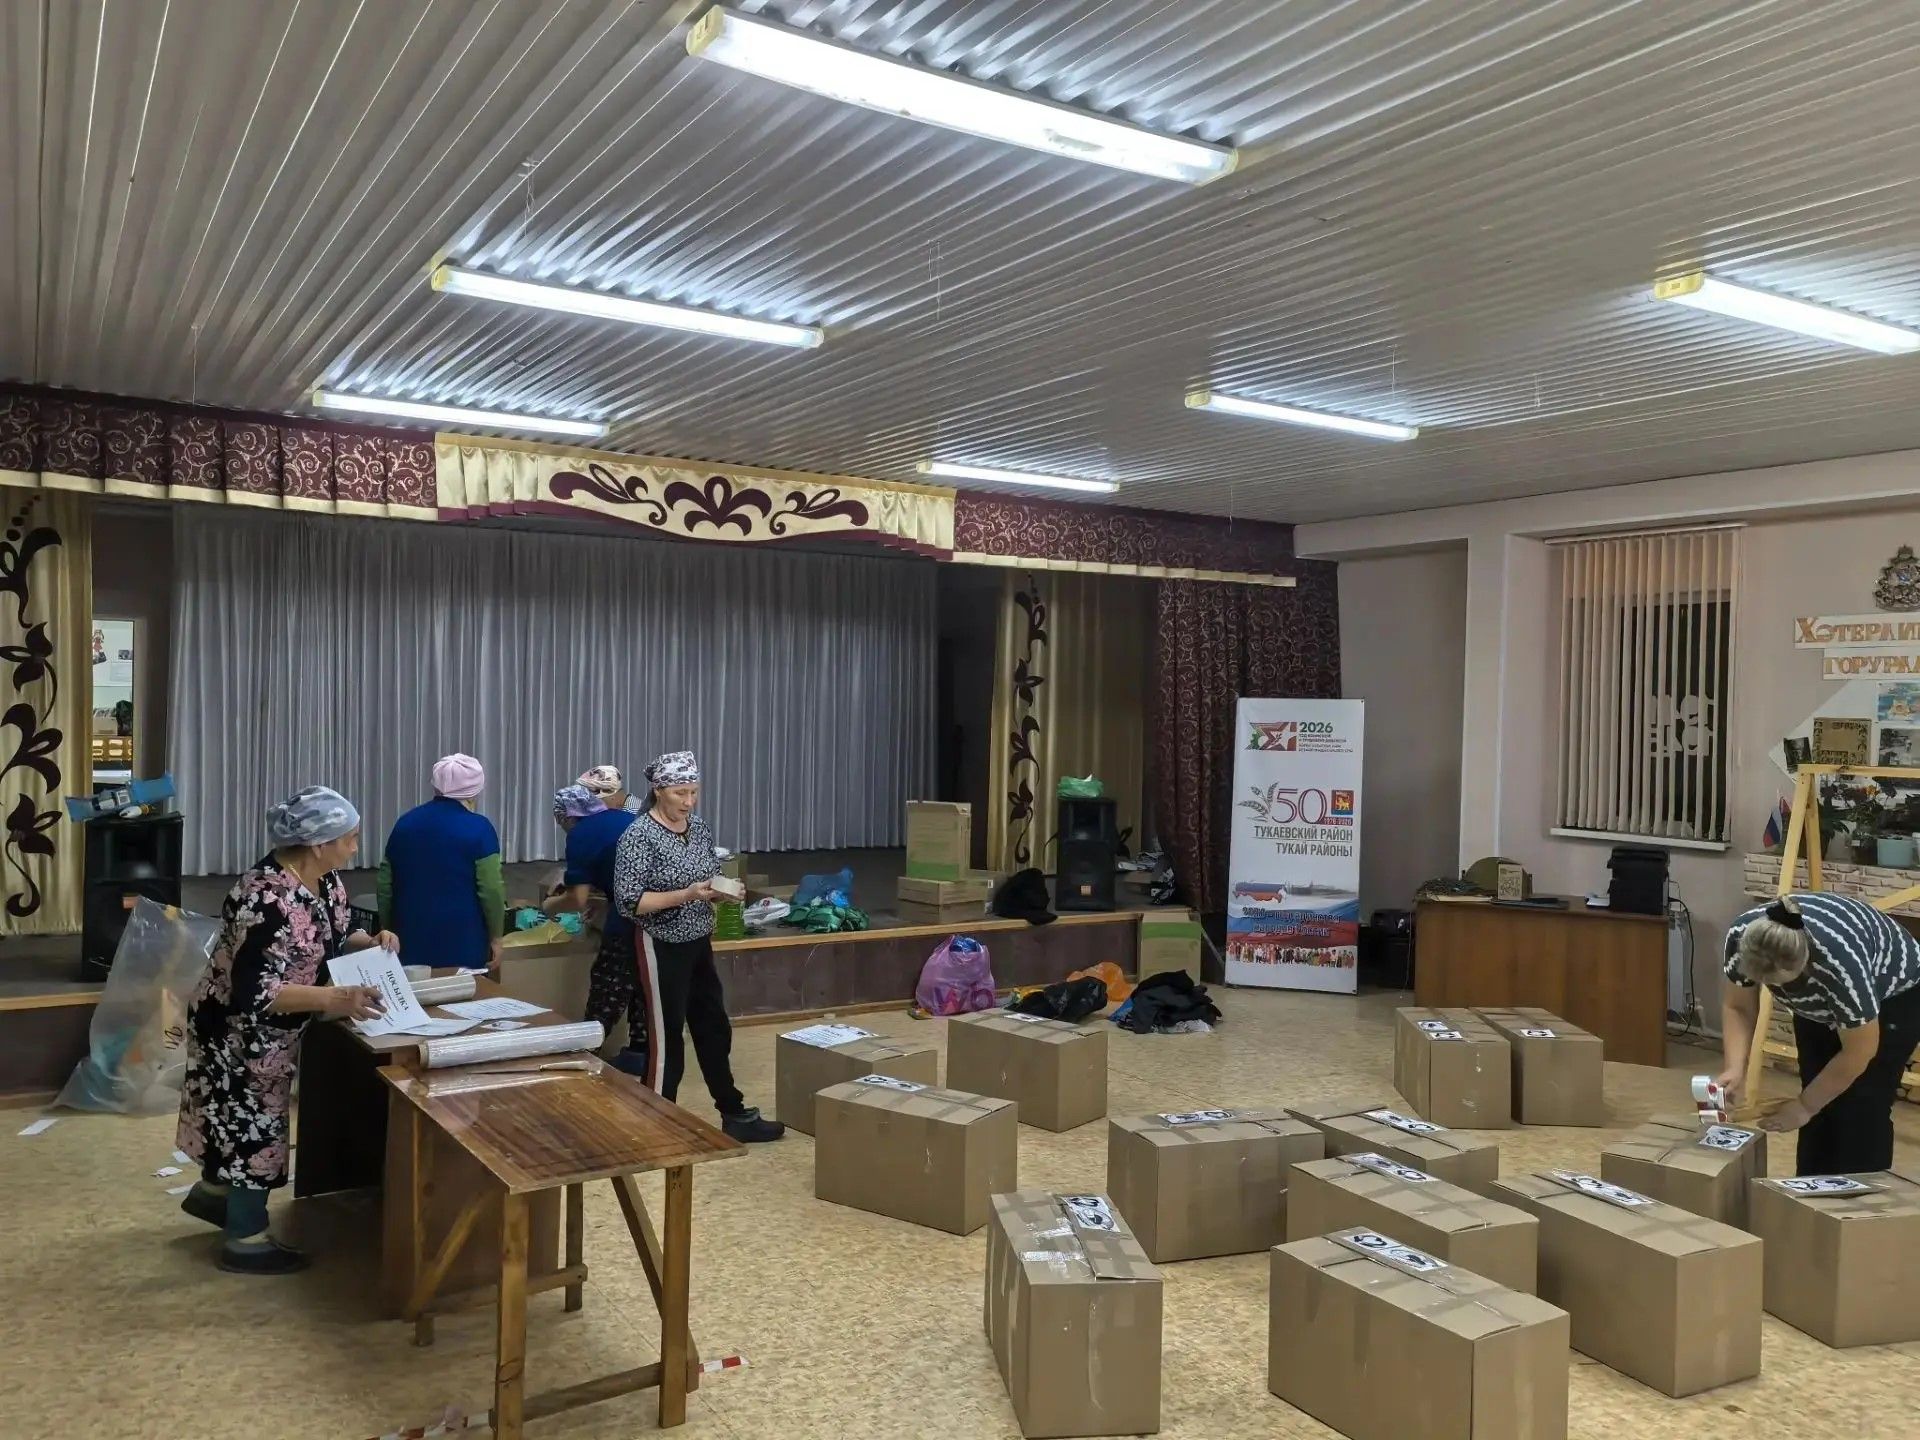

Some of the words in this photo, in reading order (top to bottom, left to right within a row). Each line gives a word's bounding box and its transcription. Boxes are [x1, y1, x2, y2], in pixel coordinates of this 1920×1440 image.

[1796, 616, 1920, 643] ХӘТЕРЛИ
[1299, 721, 1334, 733] 2026
[1272, 788, 1327, 824] 50
[1254, 826, 1317, 838] ТУКАЕВСКИЙ
[1320, 827, 1352, 840] РАЙОН
[1276, 842, 1307, 855] ТУКАЙ
[1310, 843, 1352, 857] РАЙОНЫ
[386, 970, 409, 1011] ПОСЫЛКА
